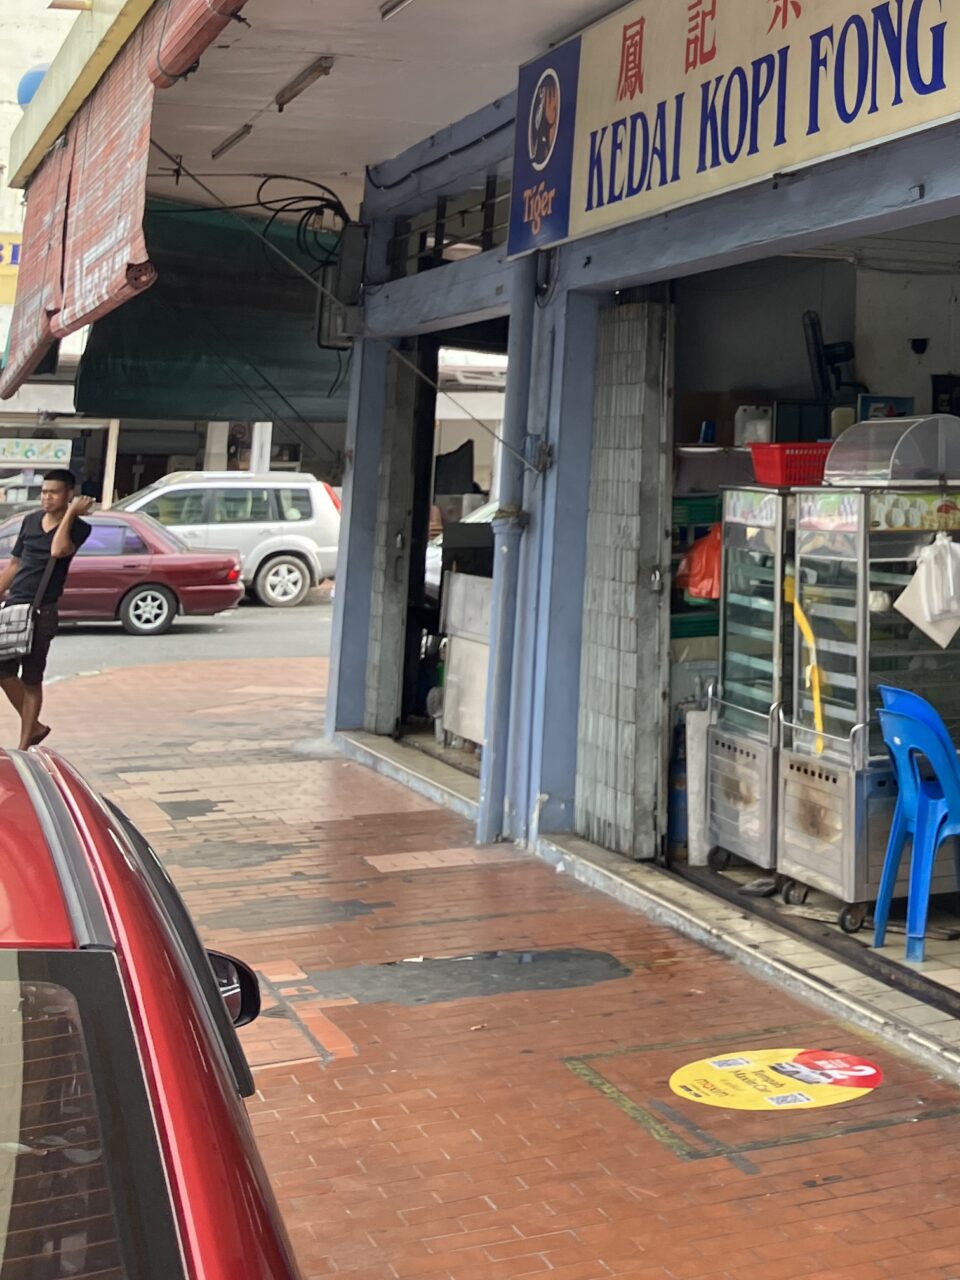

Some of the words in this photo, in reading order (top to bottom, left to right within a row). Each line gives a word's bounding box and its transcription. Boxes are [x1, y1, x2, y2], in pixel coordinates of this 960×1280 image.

[585, 92, 685, 212] KEDAI
[696, 45, 791, 174] KOPI
[523, 181, 556, 236] Tiger
